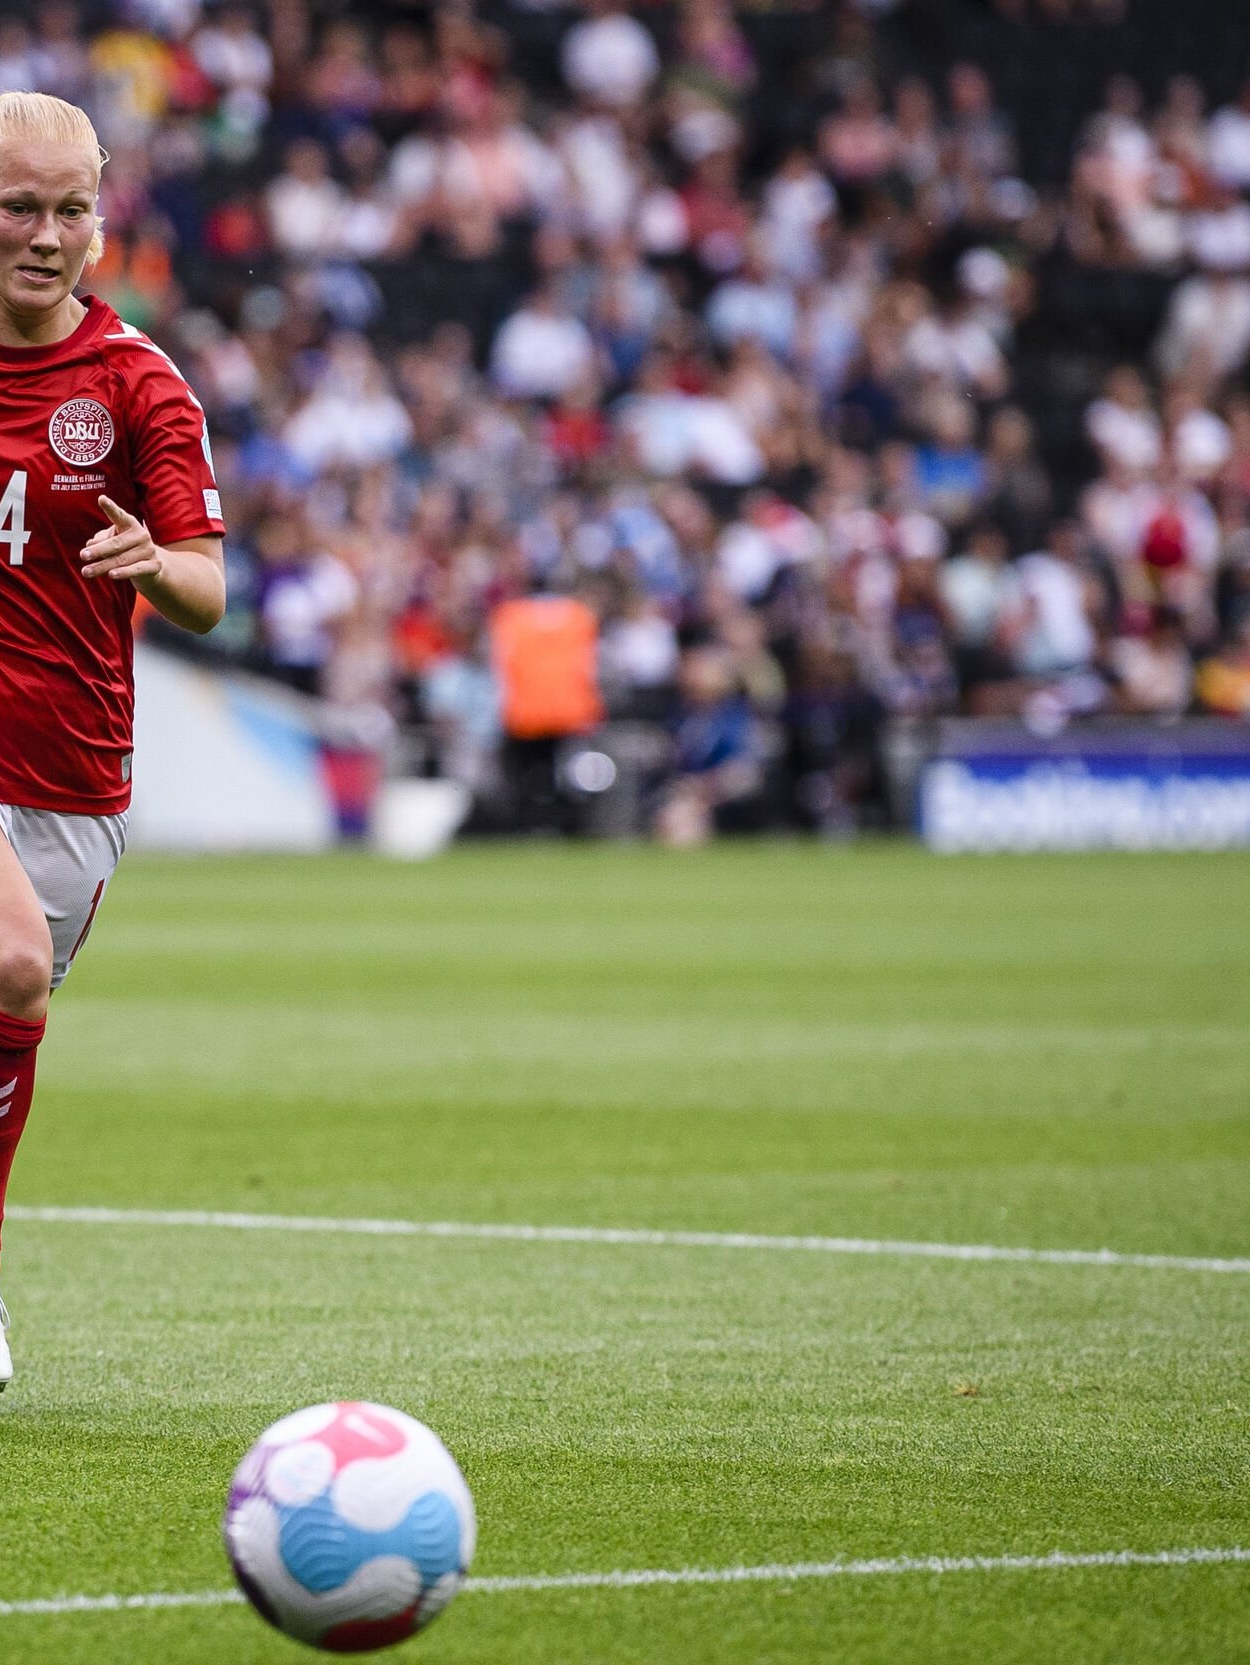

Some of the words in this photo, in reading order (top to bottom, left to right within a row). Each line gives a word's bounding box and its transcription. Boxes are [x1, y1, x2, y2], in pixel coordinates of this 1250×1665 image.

[53, 417, 68, 455] DANSK
[97, 420, 111, 455] UNION
[64, 421, 101, 440] DBU
[70, 453, 96, 462] 1889
[54, 474, 78, 482] DENMARK
[84, 474, 105, 482] FINLAND
